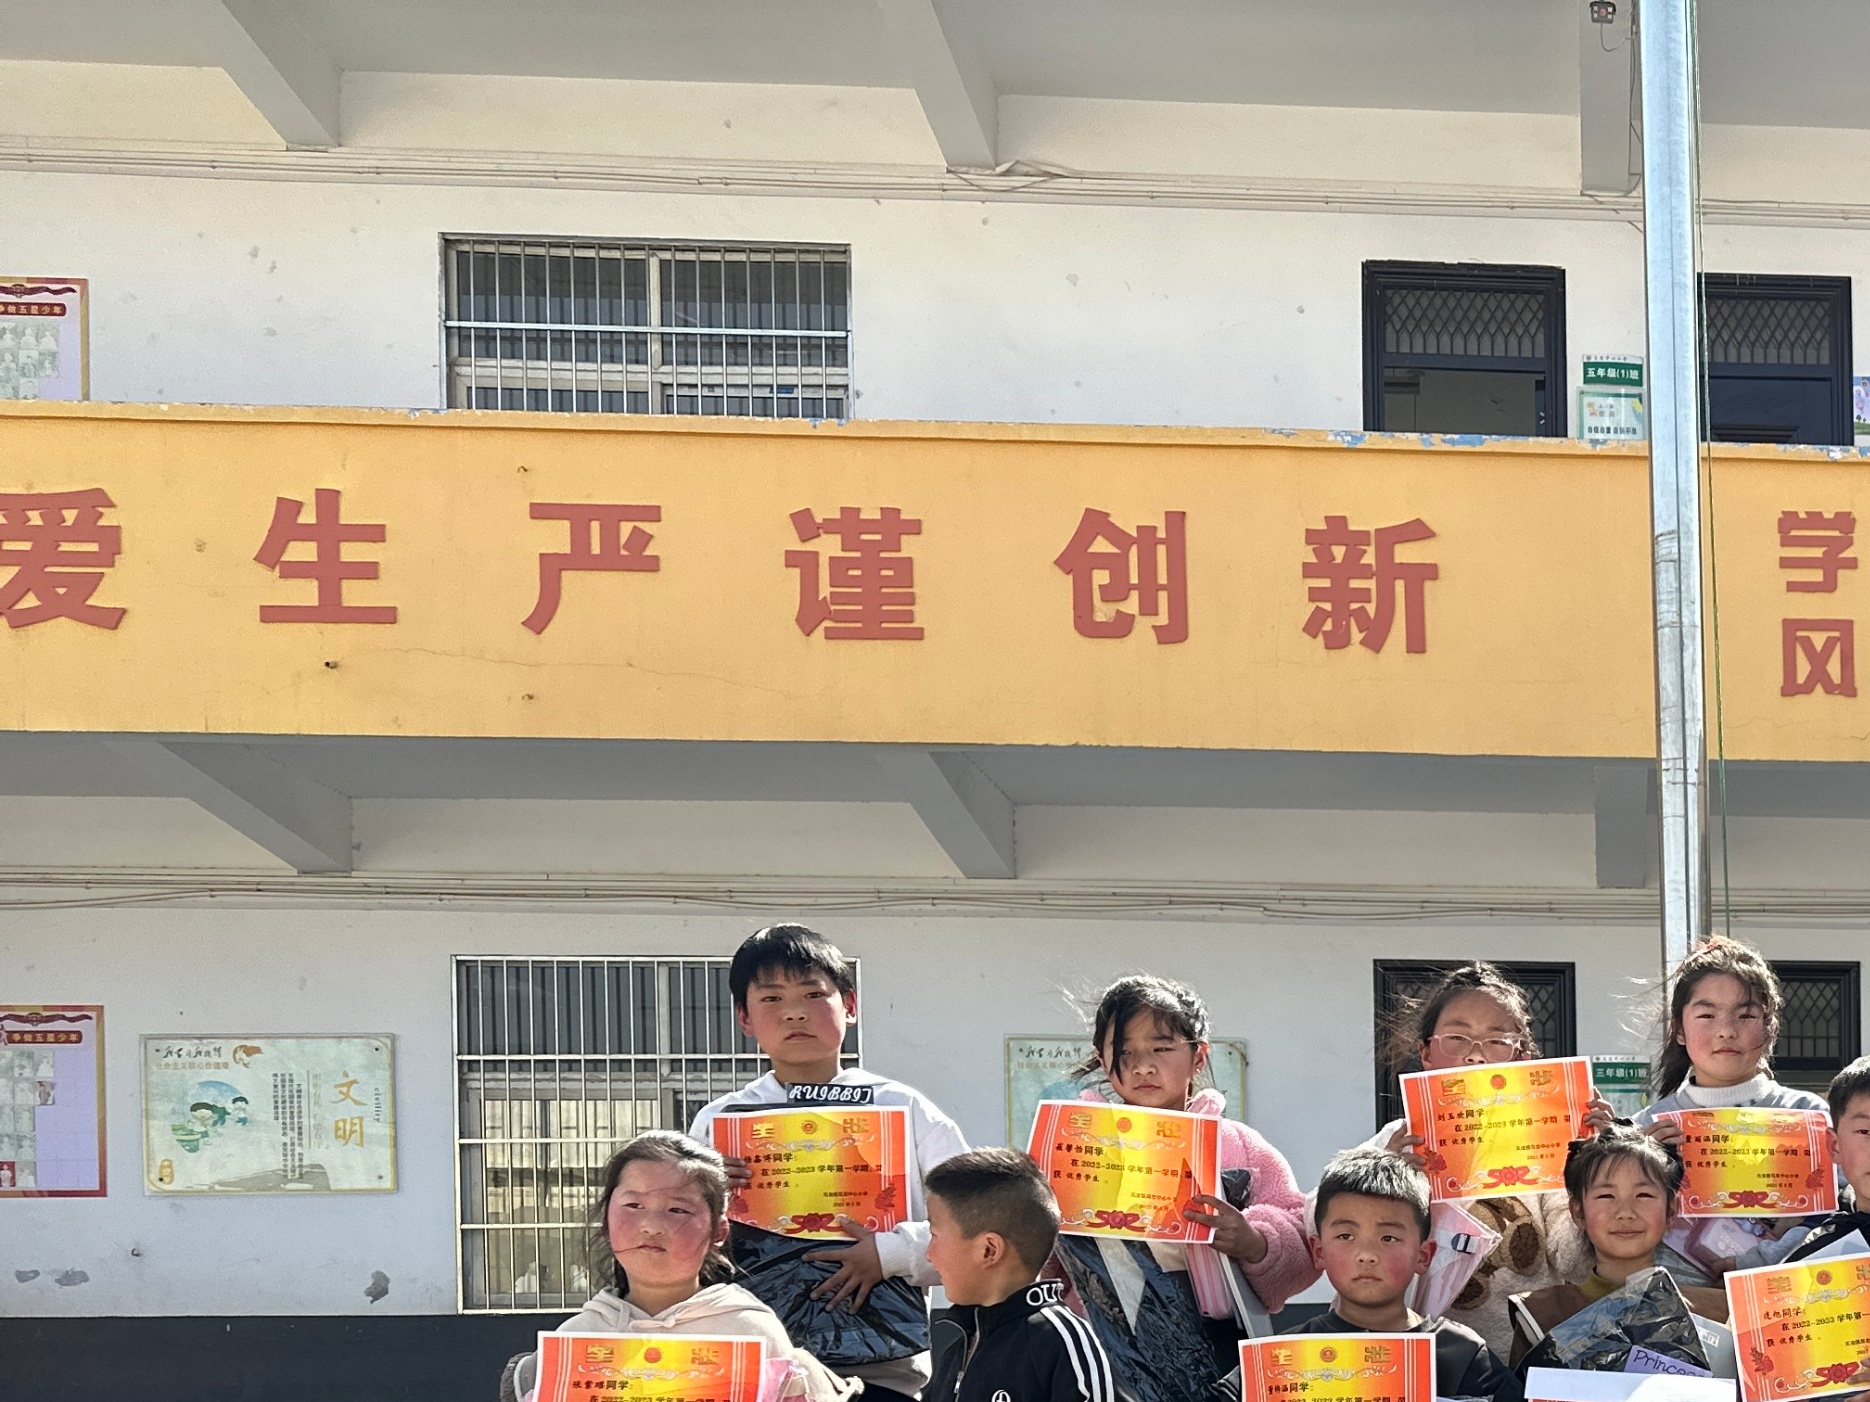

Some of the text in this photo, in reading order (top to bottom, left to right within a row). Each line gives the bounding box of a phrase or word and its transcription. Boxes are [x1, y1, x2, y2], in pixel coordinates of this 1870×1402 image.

[1586, 367, 1640, 380] 五年级(1)班
[1776, 510, 1859, 698] 学风
[330, 1070, 368, 1148] 文明
